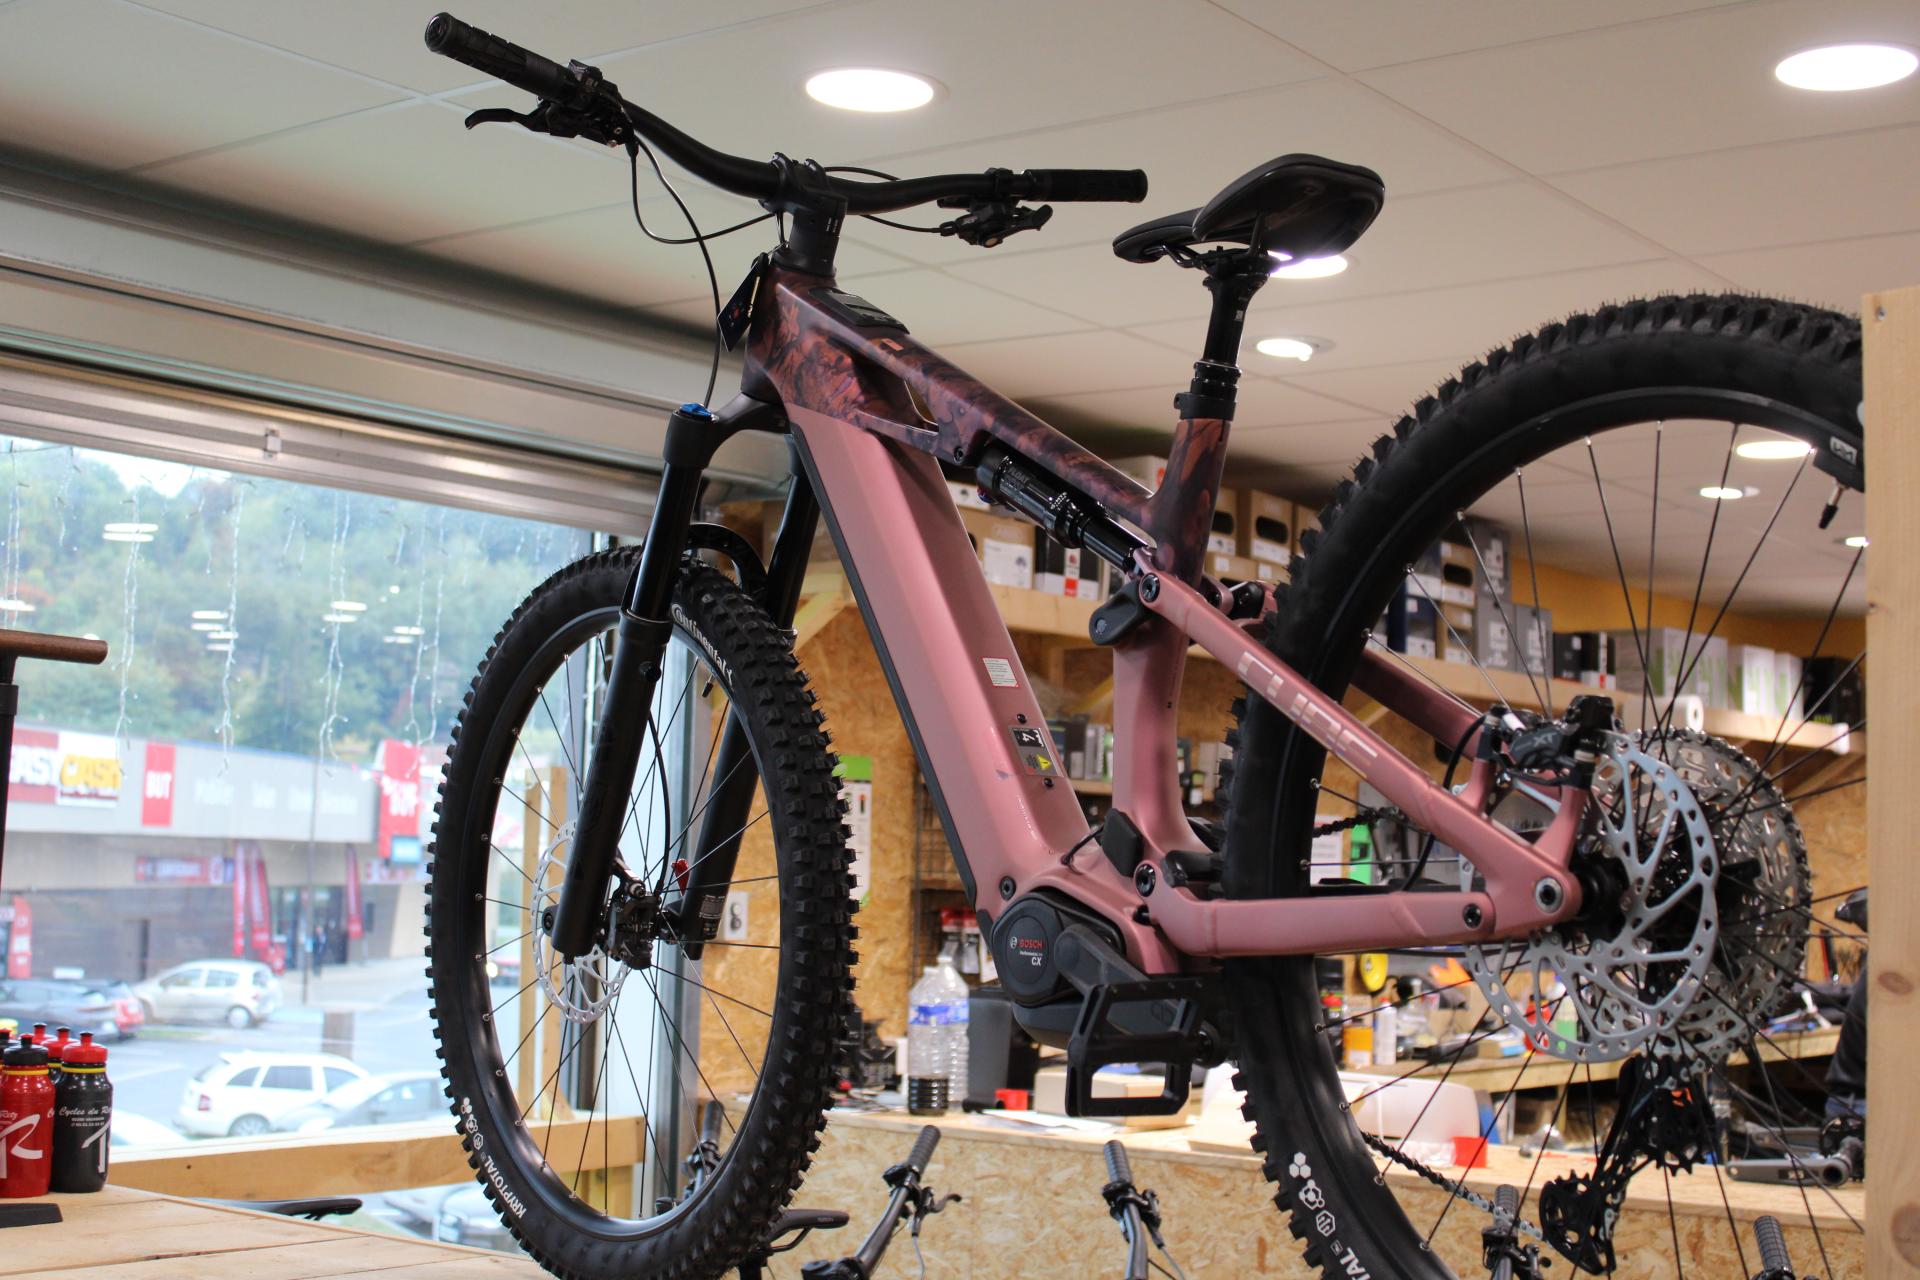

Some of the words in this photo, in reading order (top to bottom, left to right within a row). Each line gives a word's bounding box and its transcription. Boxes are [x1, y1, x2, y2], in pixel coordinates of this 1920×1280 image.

[671, 604, 727, 678] Continental
[1533, 731, 1557, 747] XT
[146, 771, 172, 799] BUT
[1019, 938, 1043, 949] BOSCH
[1031, 956, 1042, 967] CX
[59, 1106, 85, 1117] Cycles
[88, 1107, 99, 1115] du
[484, 1155, 527, 1219] KRYPTOTAL
